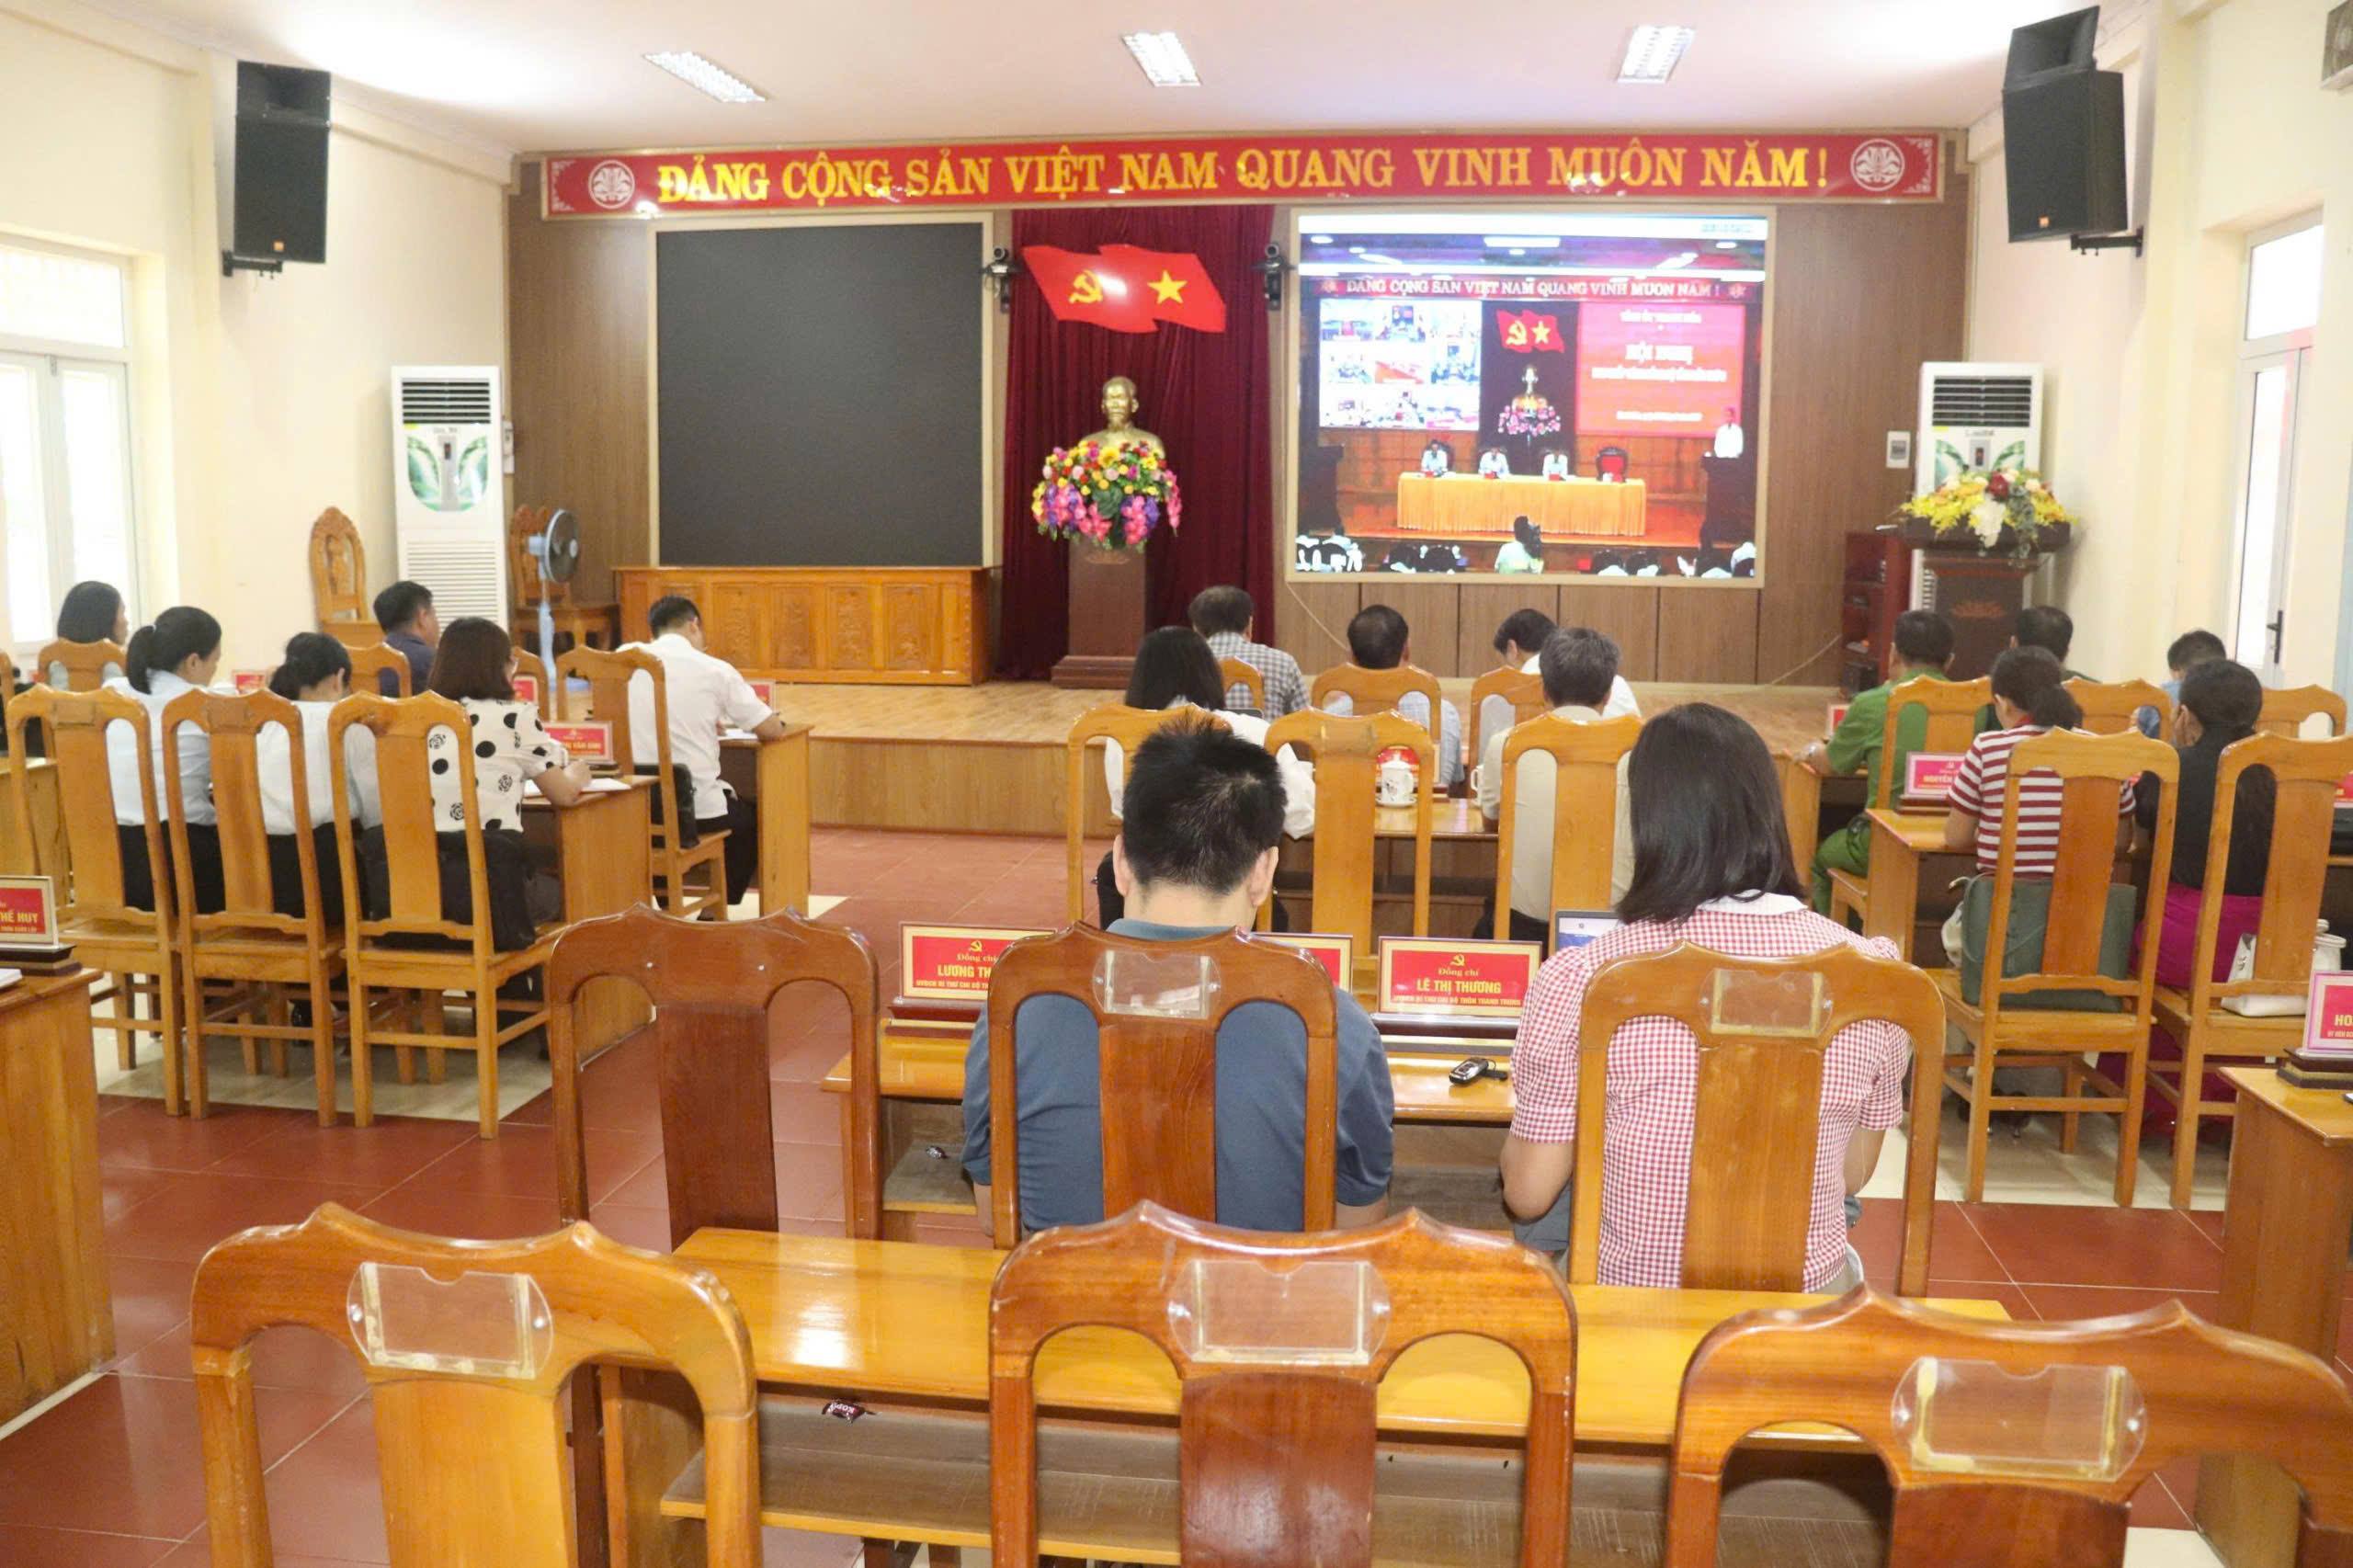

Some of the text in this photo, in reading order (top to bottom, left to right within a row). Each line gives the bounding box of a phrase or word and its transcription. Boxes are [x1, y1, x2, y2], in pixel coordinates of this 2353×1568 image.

[657, 153, 770, 203] ĐẢNG
[782, 151, 892, 207] CỘNG
[905, 148, 993, 197] SẢN
[1004, 144, 1105, 200] VIỆT
[1119, 151, 1218, 191] NAM
[1236, 149, 1395, 190] QUANG
[1412, 147, 1531, 187] VINH
[1546, 137, 1687, 187] MUÔN
[1700, 140, 1809, 187] NĂM
[1537, 281, 1587, 297] QUANG
[1590, 282, 1627, 295] VINH
[1438, 966, 1479, 977] Đồng chí
[1416, 977, 1502, 995] LÊ THỊ THƯƠNG
